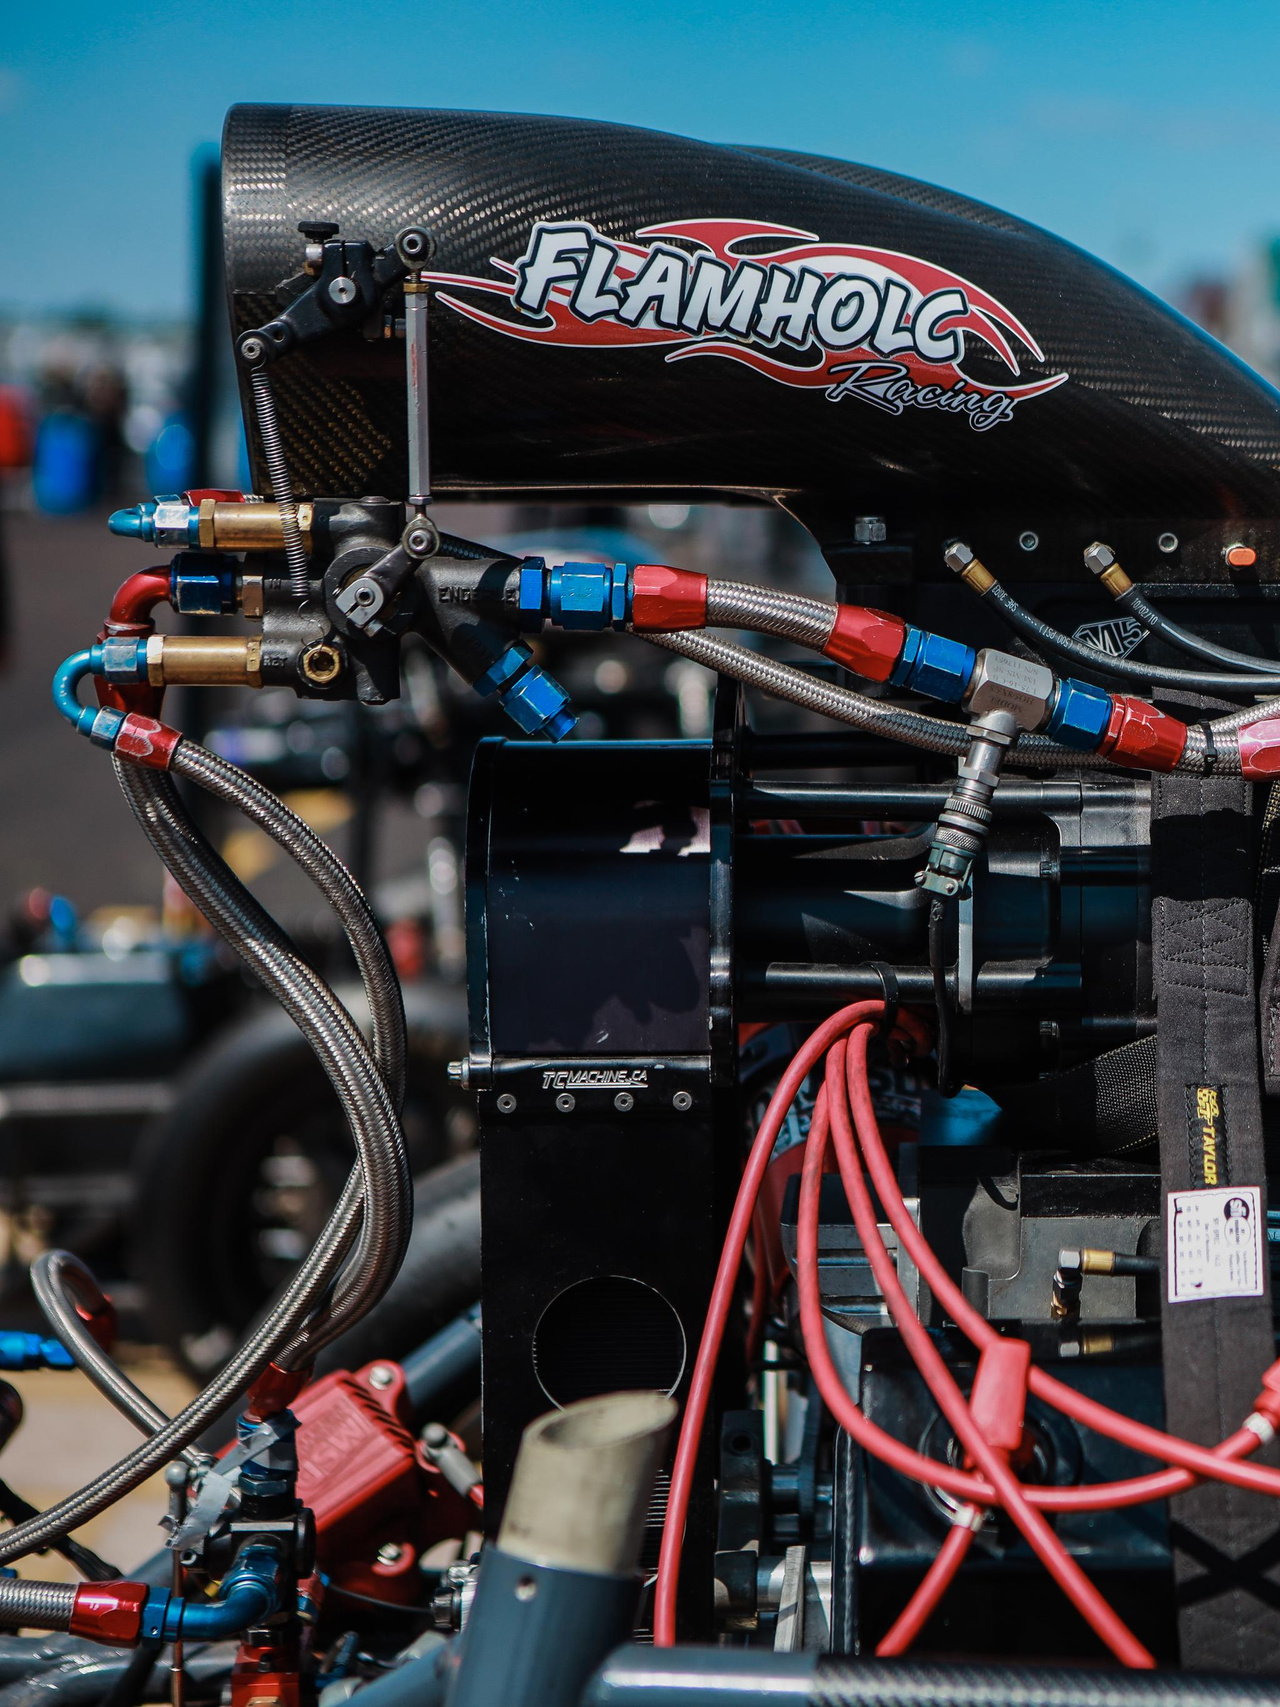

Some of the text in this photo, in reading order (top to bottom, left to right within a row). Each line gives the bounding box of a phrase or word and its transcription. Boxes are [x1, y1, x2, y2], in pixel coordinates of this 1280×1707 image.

[515, 222, 972, 365] FLAMHOLC
[825, 361, 1015, 430] Racing
[1005, 597, 1019, 613] SAE
[1130, 596, 1160, 626] 10/02/10
[1038, 622, 1057, 639] PSI)
[1203, 1126, 1218, 1186] TAYLOR
